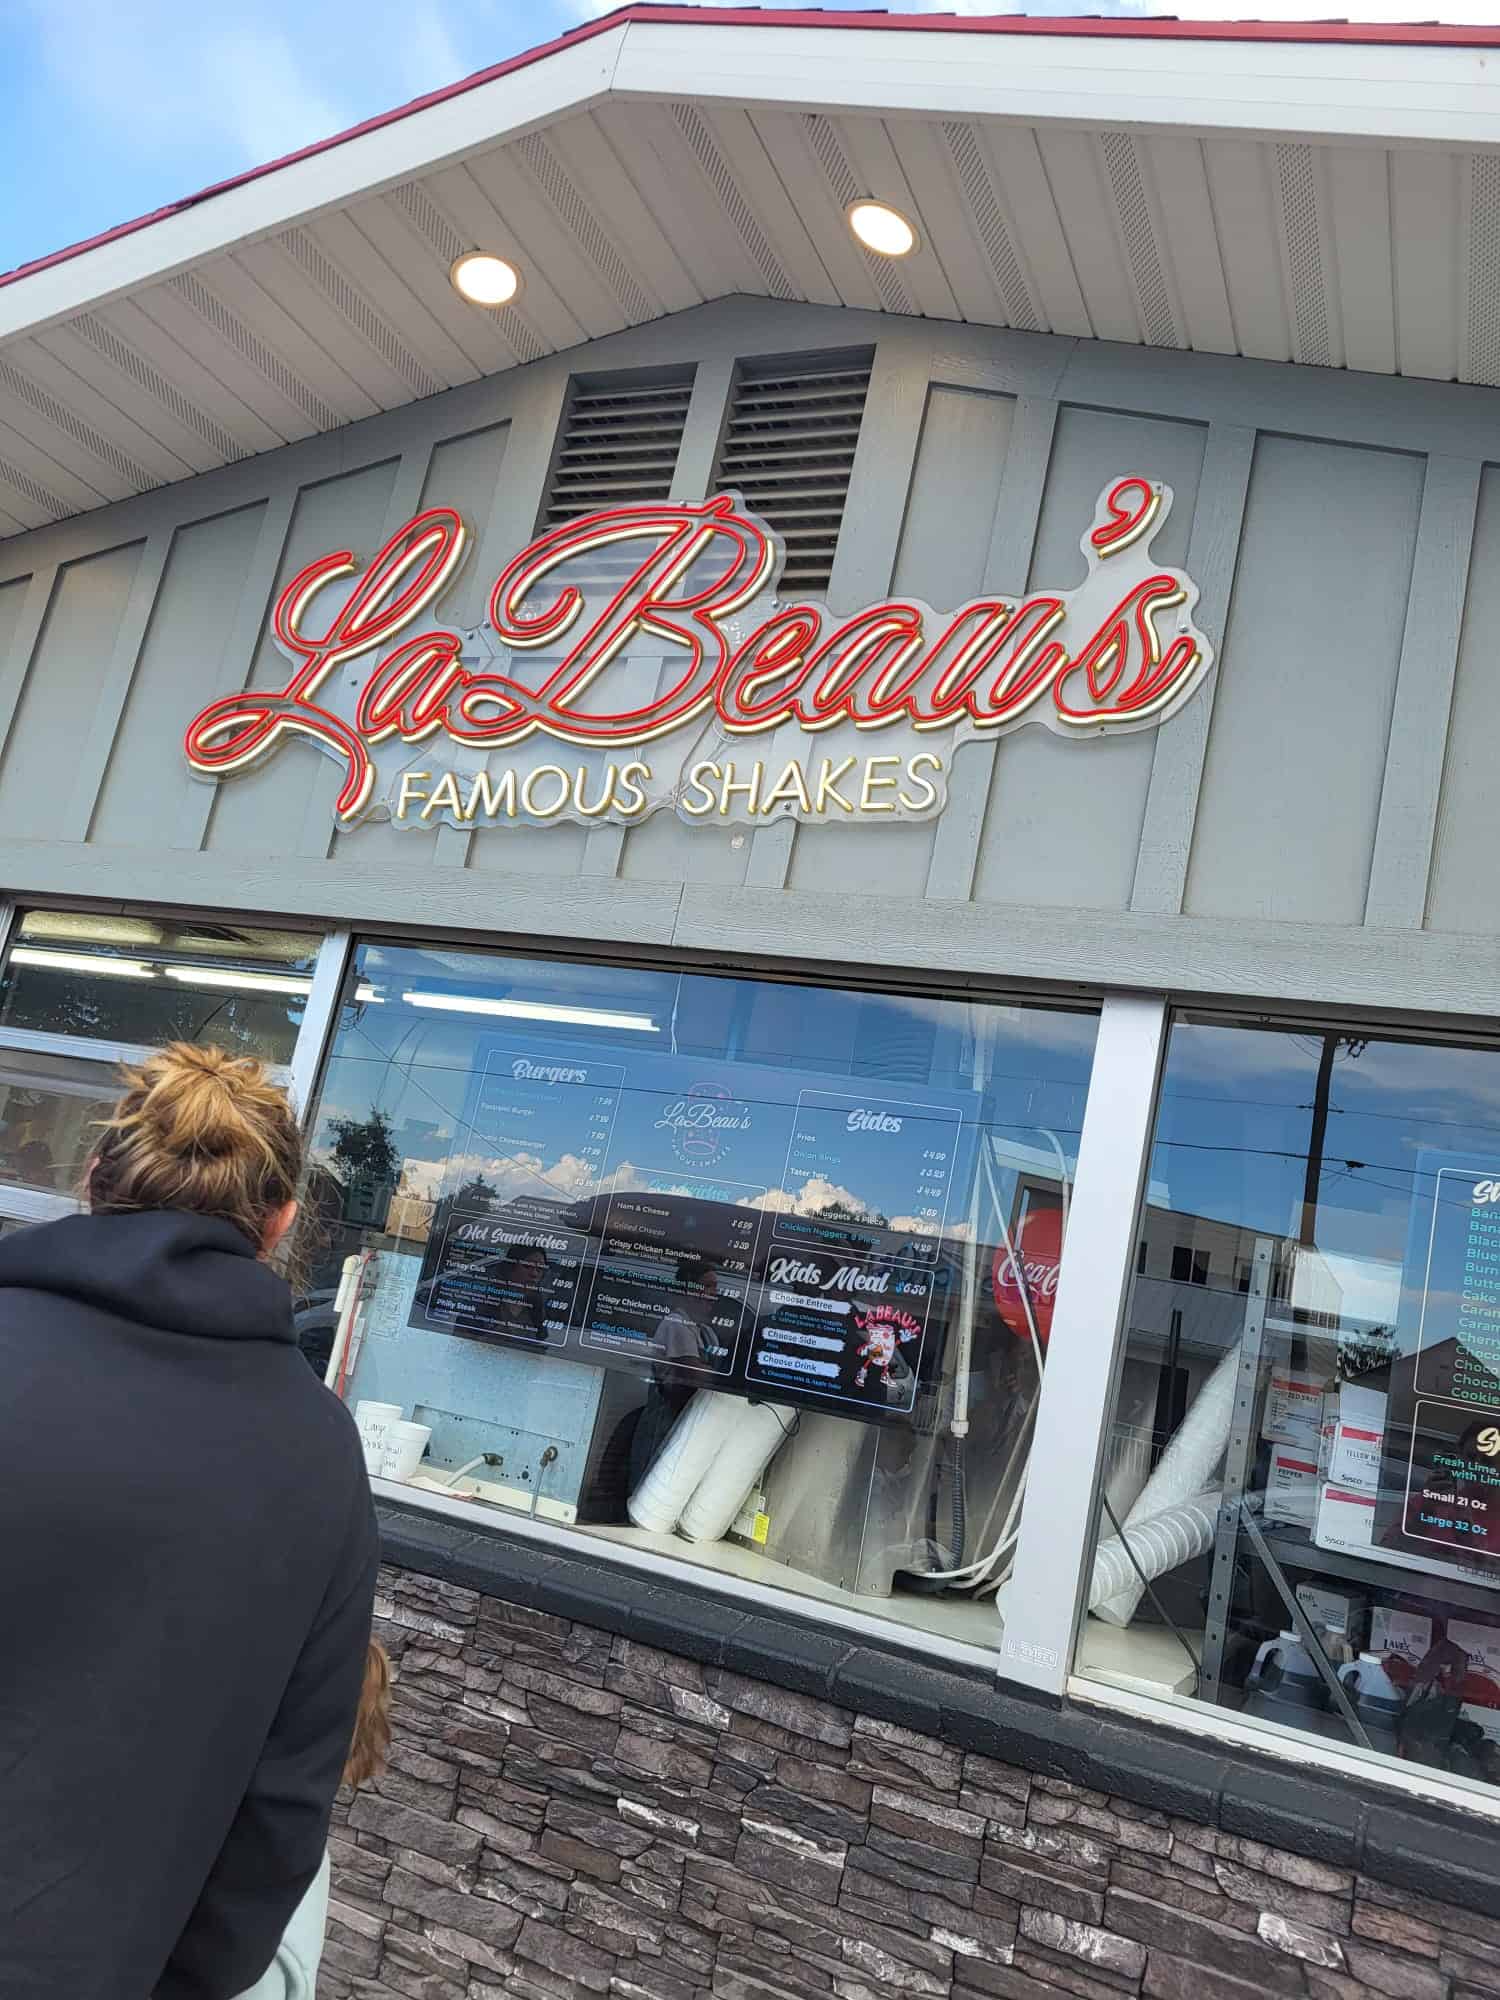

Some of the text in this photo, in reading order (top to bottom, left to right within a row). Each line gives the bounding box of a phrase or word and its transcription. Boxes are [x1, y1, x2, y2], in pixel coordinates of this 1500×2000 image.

[184, 477, 1202, 821] LaBeau's
[397, 751, 942, 820] FAMOUS SHAKES
[511, 1059, 588, 1085] Burgers
[654, 1101, 752, 1135] LaBeau's
[846, 1108, 903, 1132] Sides
[457, 1223, 487, 1241] Hot
[491, 1228, 569, 1252] Sandwiches
[609, 1238, 633, 1250] Crispy
[633, 1241, 664, 1255] Chicken
[664, 1247, 702, 1261] Sandwich
[769, 1257, 822, 1285] Kids
[819, 1265, 891, 1294] Meal
[597, 1293, 621, 1306] Crispy
[621, 1297, 652, 1311] Chicken
[652, 1303, 672, 1315] Club
[774, 1293, 805, 1305] Choose
[1462, 1289, 1497, 1304] Cake
[767, 1330, 798, 1342] Choose
[762, 1353, 817, 1373] Choose Drink
[1432, 1454, 1465, 1469] Fresh
[1422, 1488, 1488, 1512] Small 21 Oz
[1420, 1512, 1488, 1536] Large 32 Oz
